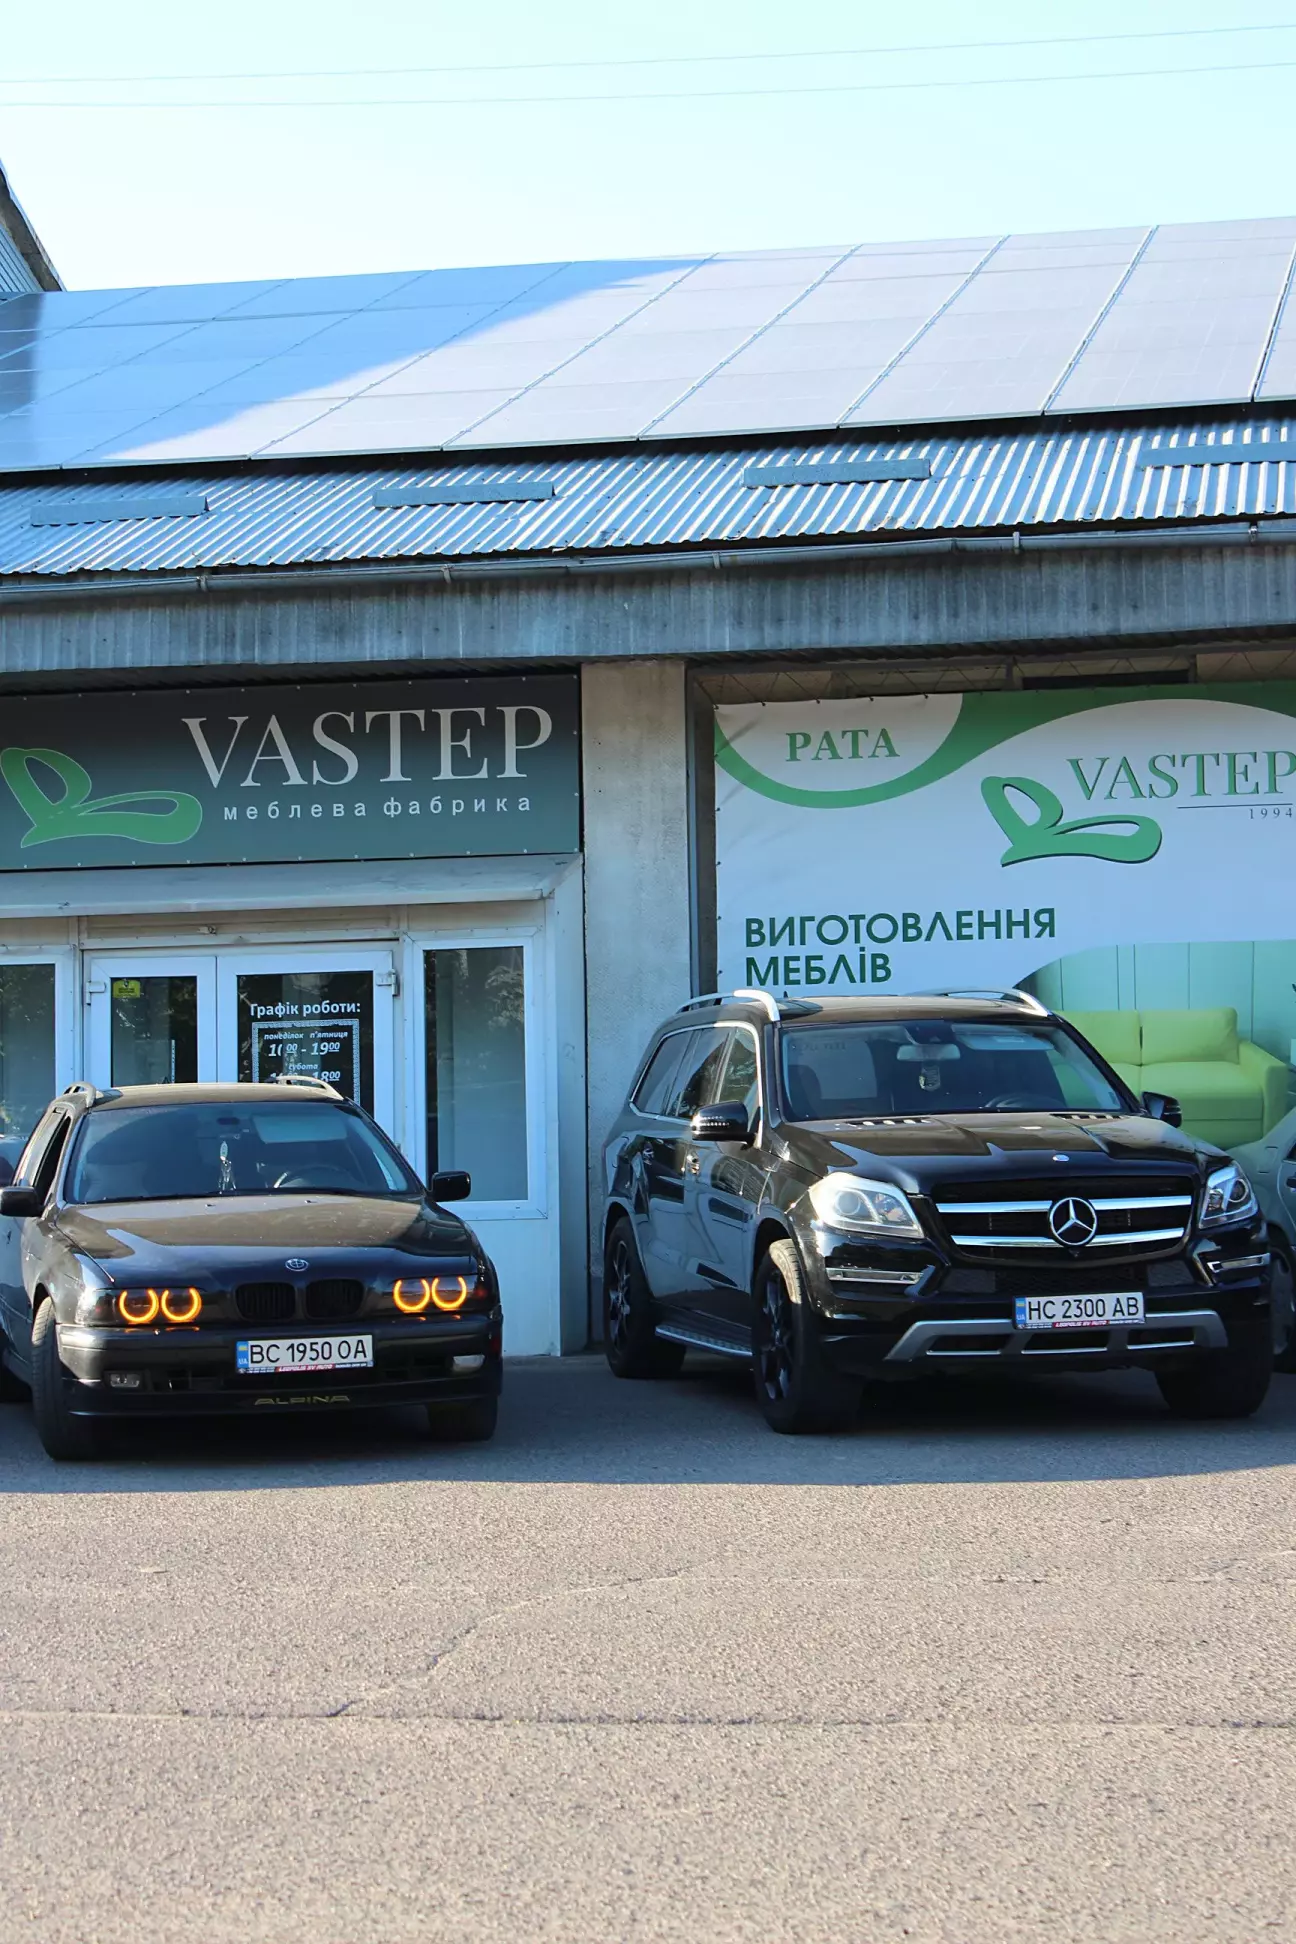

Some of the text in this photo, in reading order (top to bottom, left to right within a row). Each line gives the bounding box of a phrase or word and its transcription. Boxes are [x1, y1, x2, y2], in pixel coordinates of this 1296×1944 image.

[181, 705, 553, 789] VASTEP
[1066, 750, 1296, 801] VASTEP
[223, 796, 531, 821] меблева фабрика
[1249, 807, 1293, 820] 1994
[745, 907, 1056, 948] ВИГОТОВЛЕННЯ
[745, 946, 892, 987] МЕБЛІВ
[250, 1000, 361, 1019] Графік роботи:
[1028, 1296, 1140, 1320] HC 2300 AB
[250, 1339, 367, 1364] BC 1950 OA
[254, 1395, 351, 1406] ALPINA
